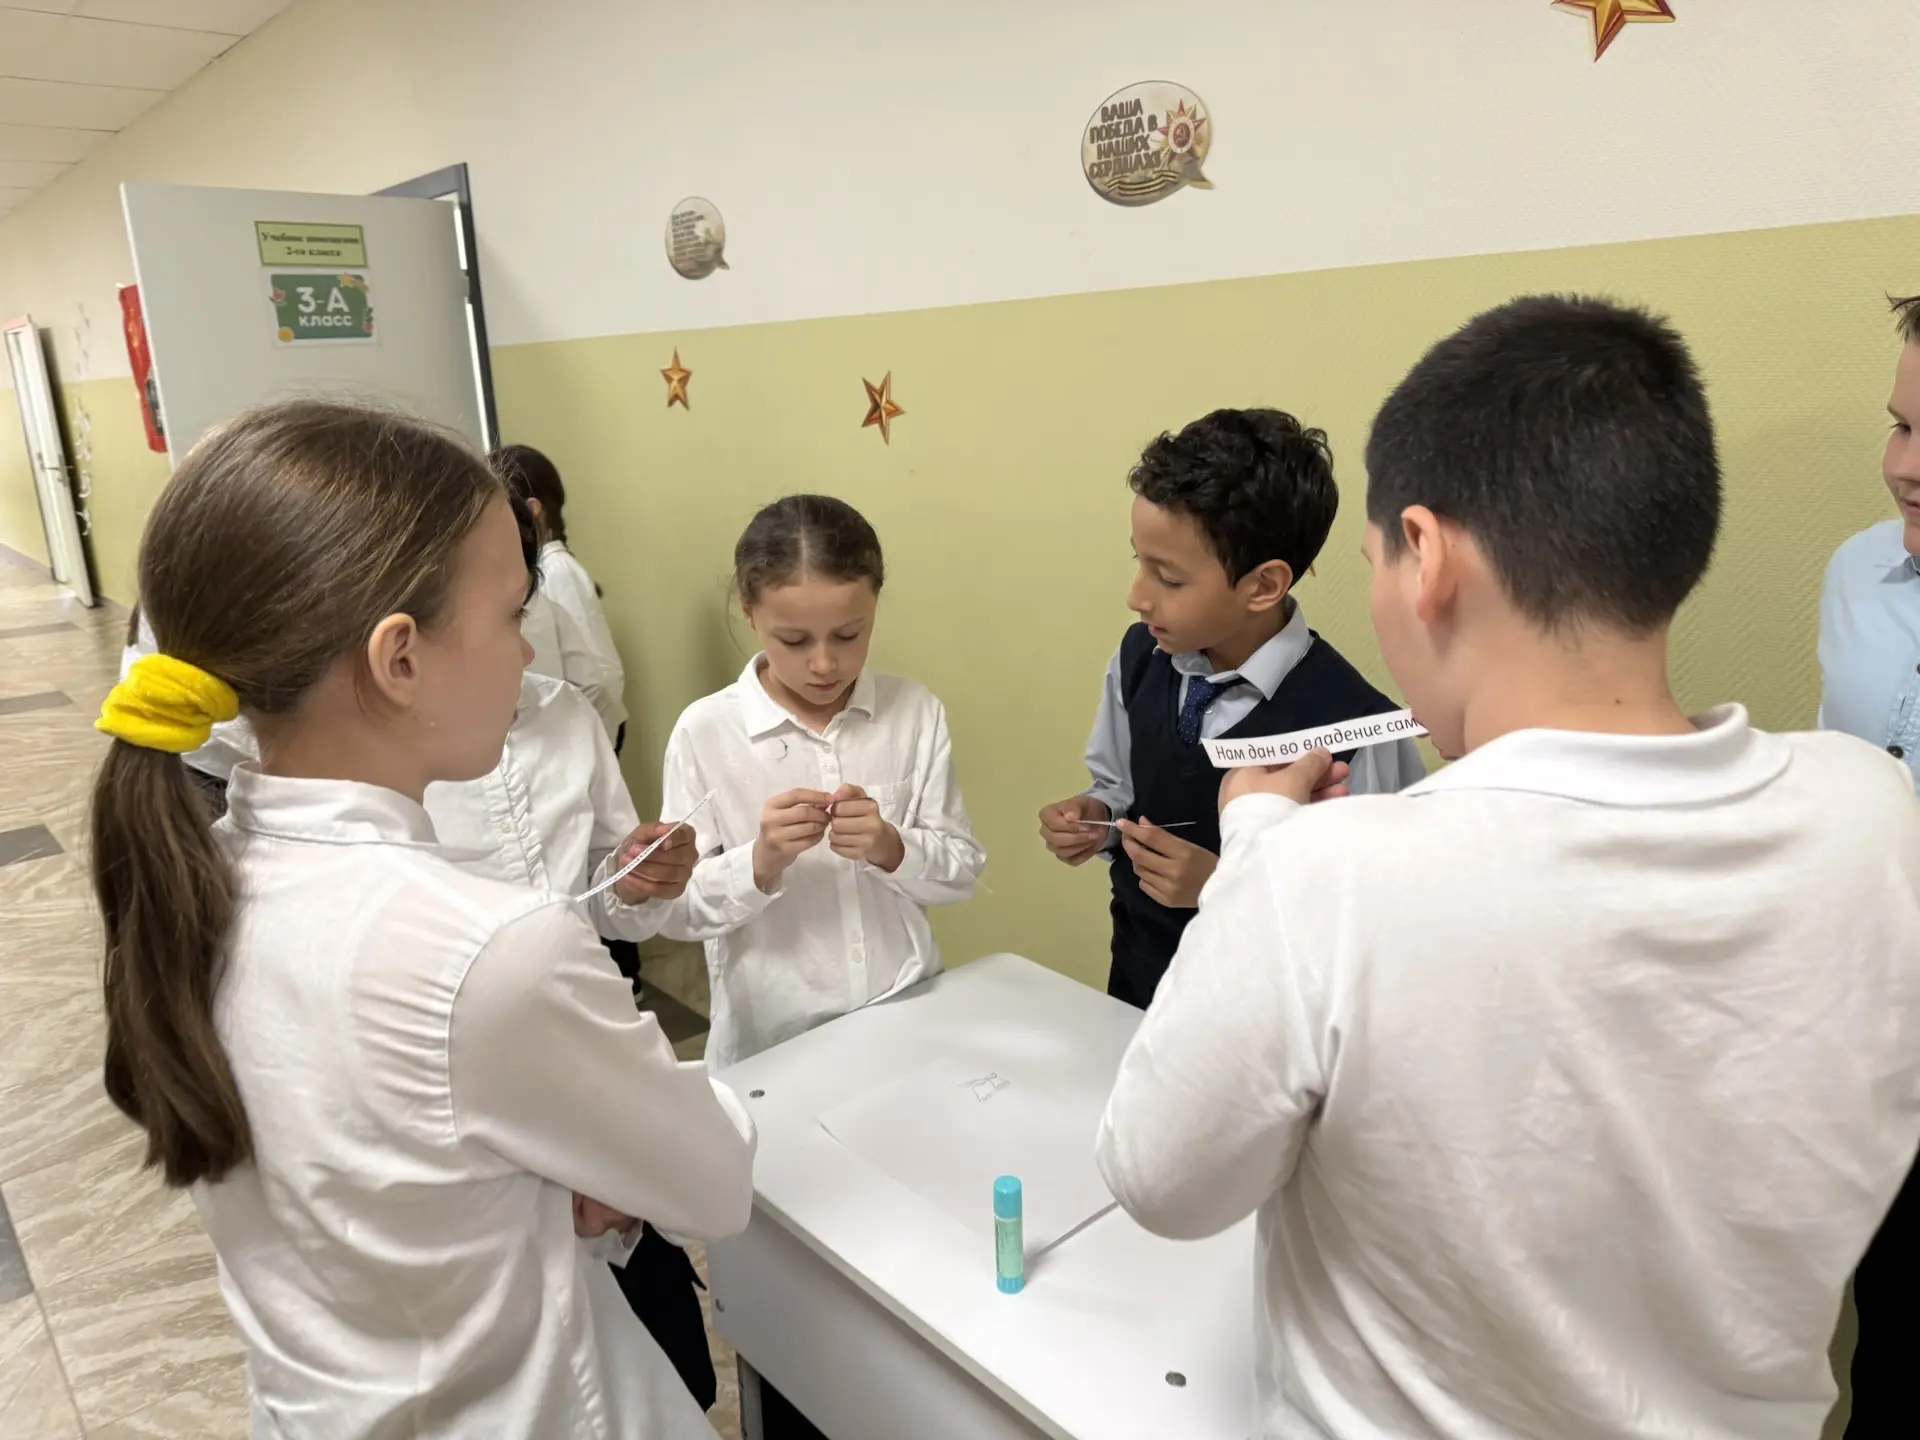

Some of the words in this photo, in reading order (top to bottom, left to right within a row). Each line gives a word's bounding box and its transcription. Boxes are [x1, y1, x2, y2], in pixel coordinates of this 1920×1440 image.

[1101, 98, 1143, 123] ВАША
[1089, 116, 1145, 144] ПОБЕДА
[1147, 114, 1158, 132] В
[1096, 134, 1150, 160] НАШИХ
[296, 286, 350, 313] 3-А
[298, 315, 353, 327] класс
[1215, 745, 1246, 762] Нам
[1248, 743, 1276, 759] дан
[1279, 742, 1299, 757] во
[1303, 724, 1383, 751] владение
